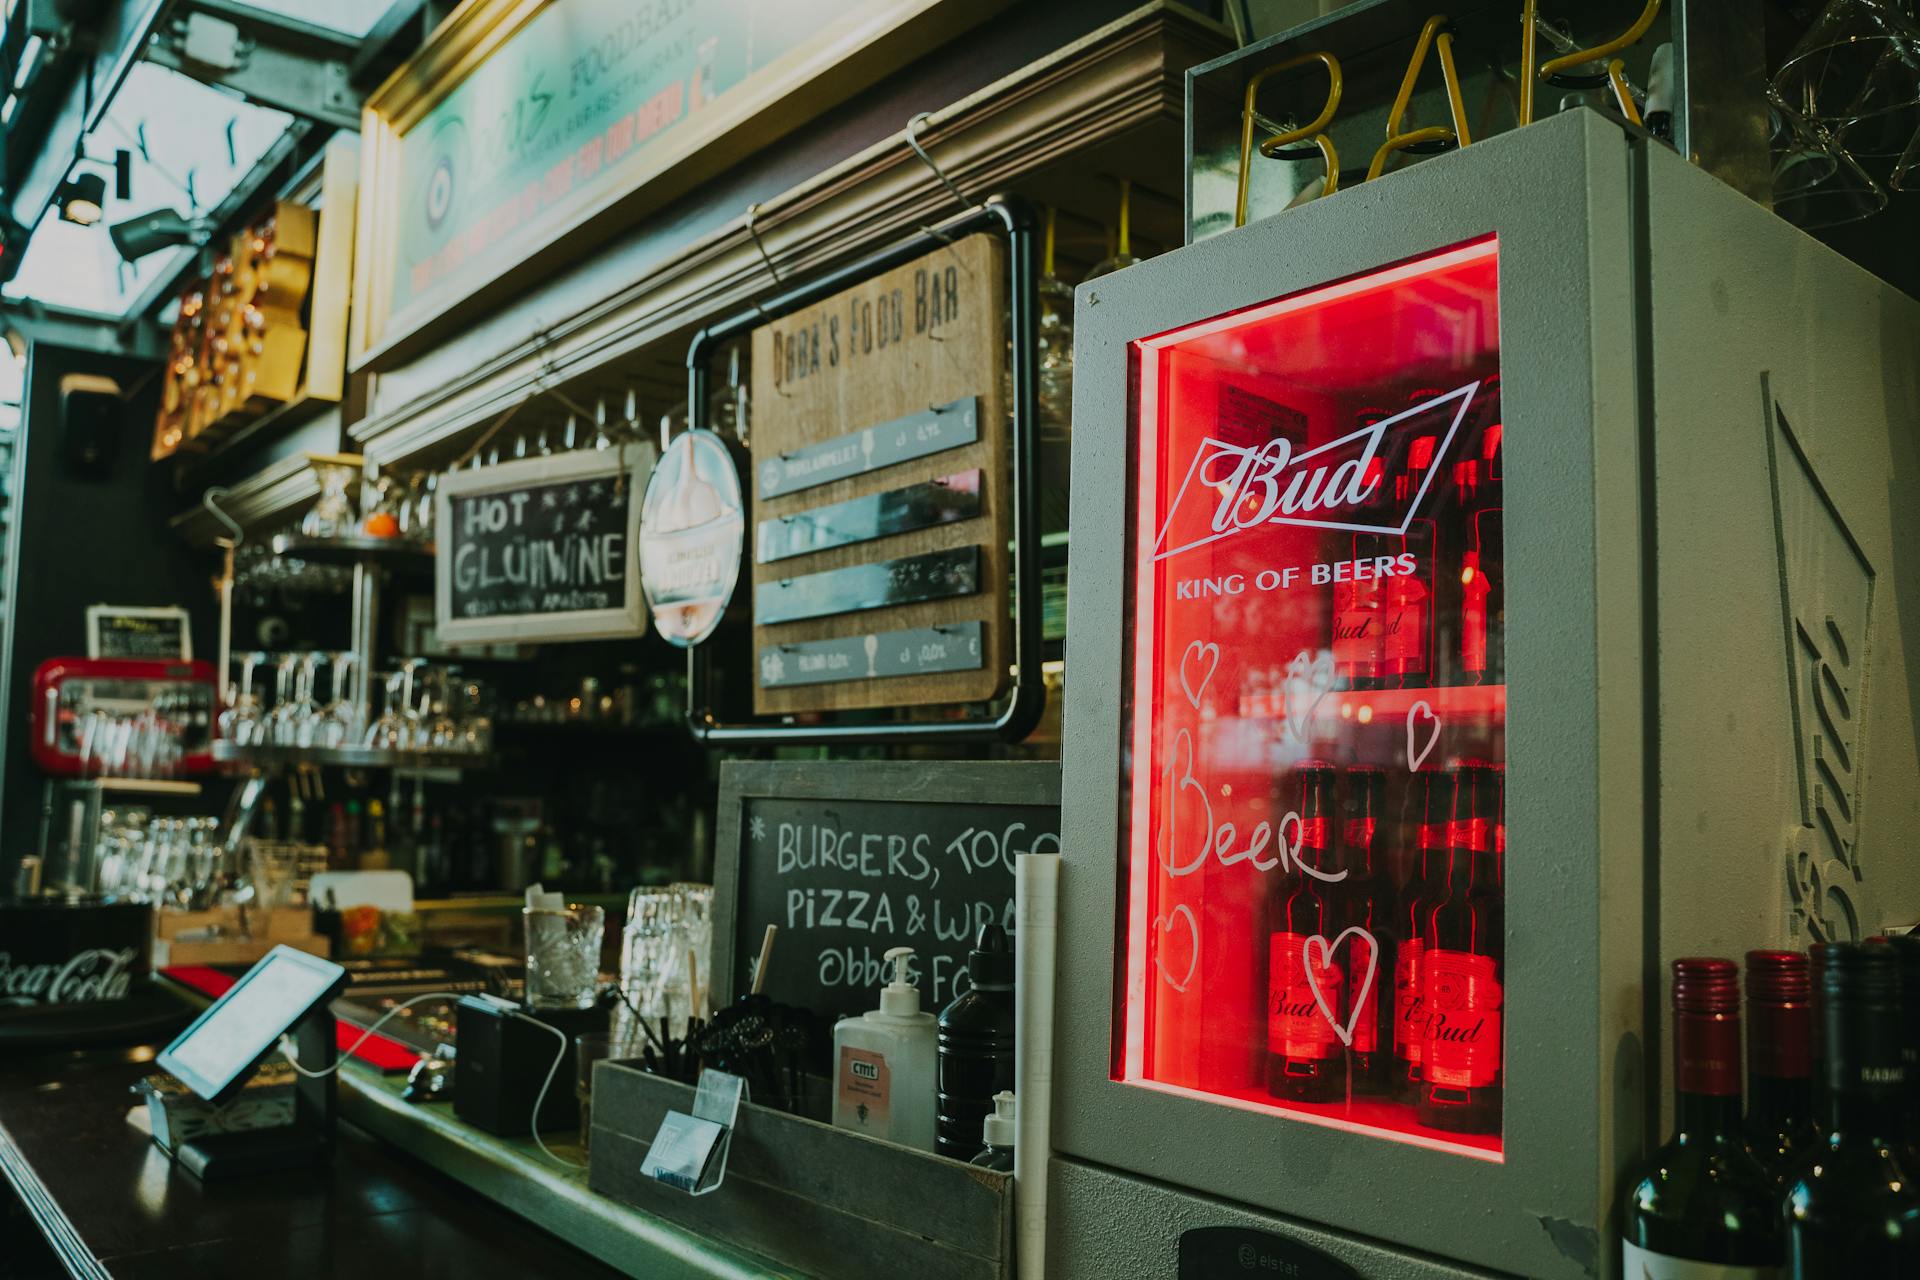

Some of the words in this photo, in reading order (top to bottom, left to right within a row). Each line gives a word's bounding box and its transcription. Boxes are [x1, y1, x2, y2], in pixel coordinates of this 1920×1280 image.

[850, 288, 903, 355] FOOD
[914, 265, 959, 335] BAR
[1200, 424, 1387, 533] Bud
[463, 492, 530, 535] HOT
[1176, 574, 1245, 600] KING
[1255, 567, 1300, 590] OF
[1311, 552, 1417, 586] BEERS
[777, 822, 940, 890] BURGERS,
[906, 894, 927, 936] &
[1269, 990, 1318, 1018] Bud
[1423, 1011, 1485, 1042] Bud
[852, 1062, 876, 1078] cmt
[1260, 1256, 1300, 1278] elstat
